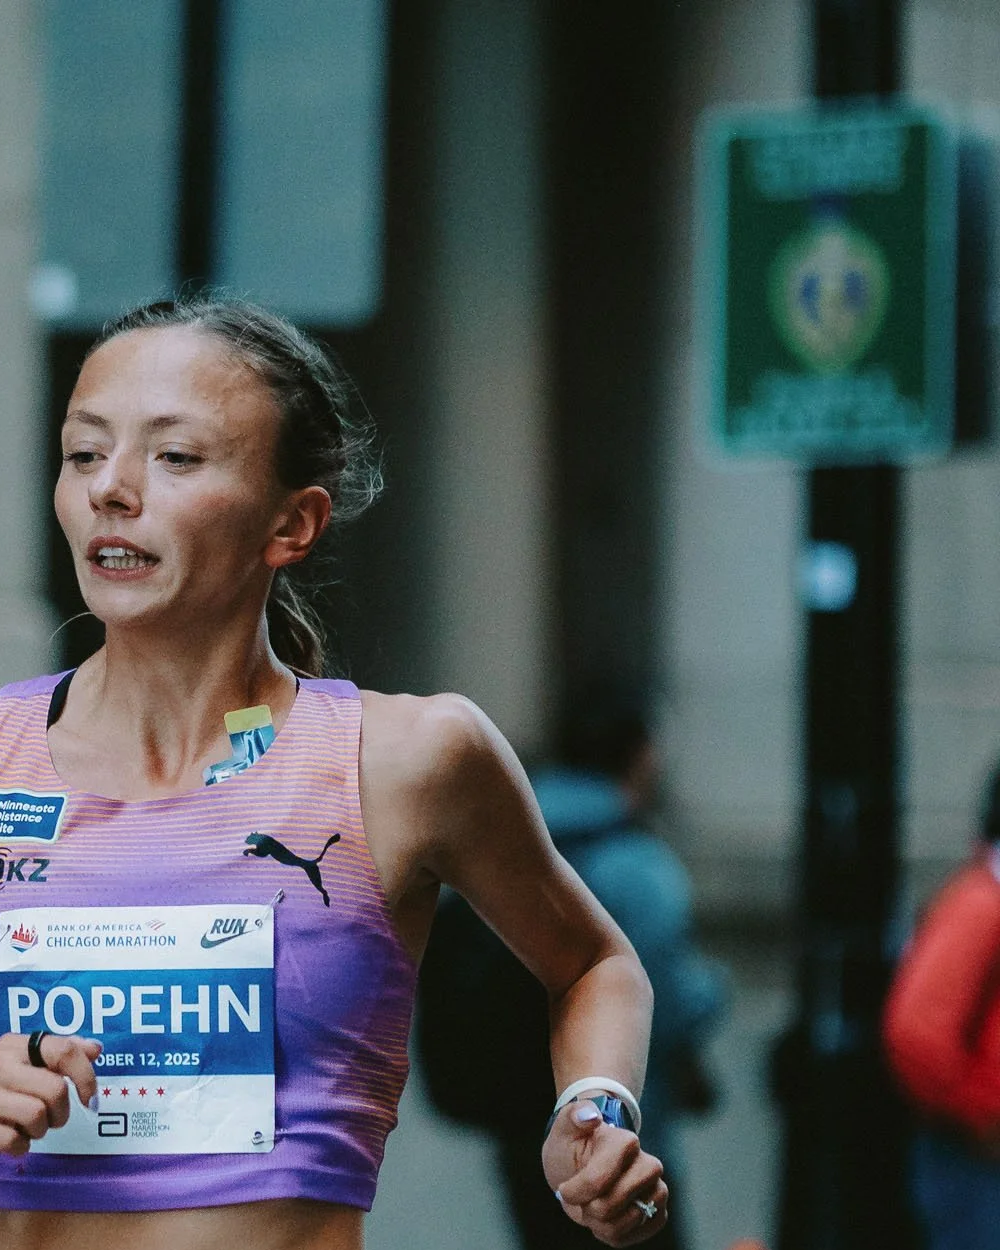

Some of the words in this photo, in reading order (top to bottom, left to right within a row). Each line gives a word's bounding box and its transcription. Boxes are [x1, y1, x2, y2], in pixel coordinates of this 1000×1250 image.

[47, 924, 76, 932] BANK
[78, 924, 92, 932] OF
[95, 924, 143, 932] AMERICA
[210, 918, 249, 936] RUN
[46, 936, 101, 948] CHICAGO
[105, 935, 177, 948] MARATHON
[7, 984, 261, 1035] POPEHN
[95, 1053, 135, 1067] OBER
[139, 1053, 161, 1068] 12,
[164, 1052, 200, 1066] 2025
